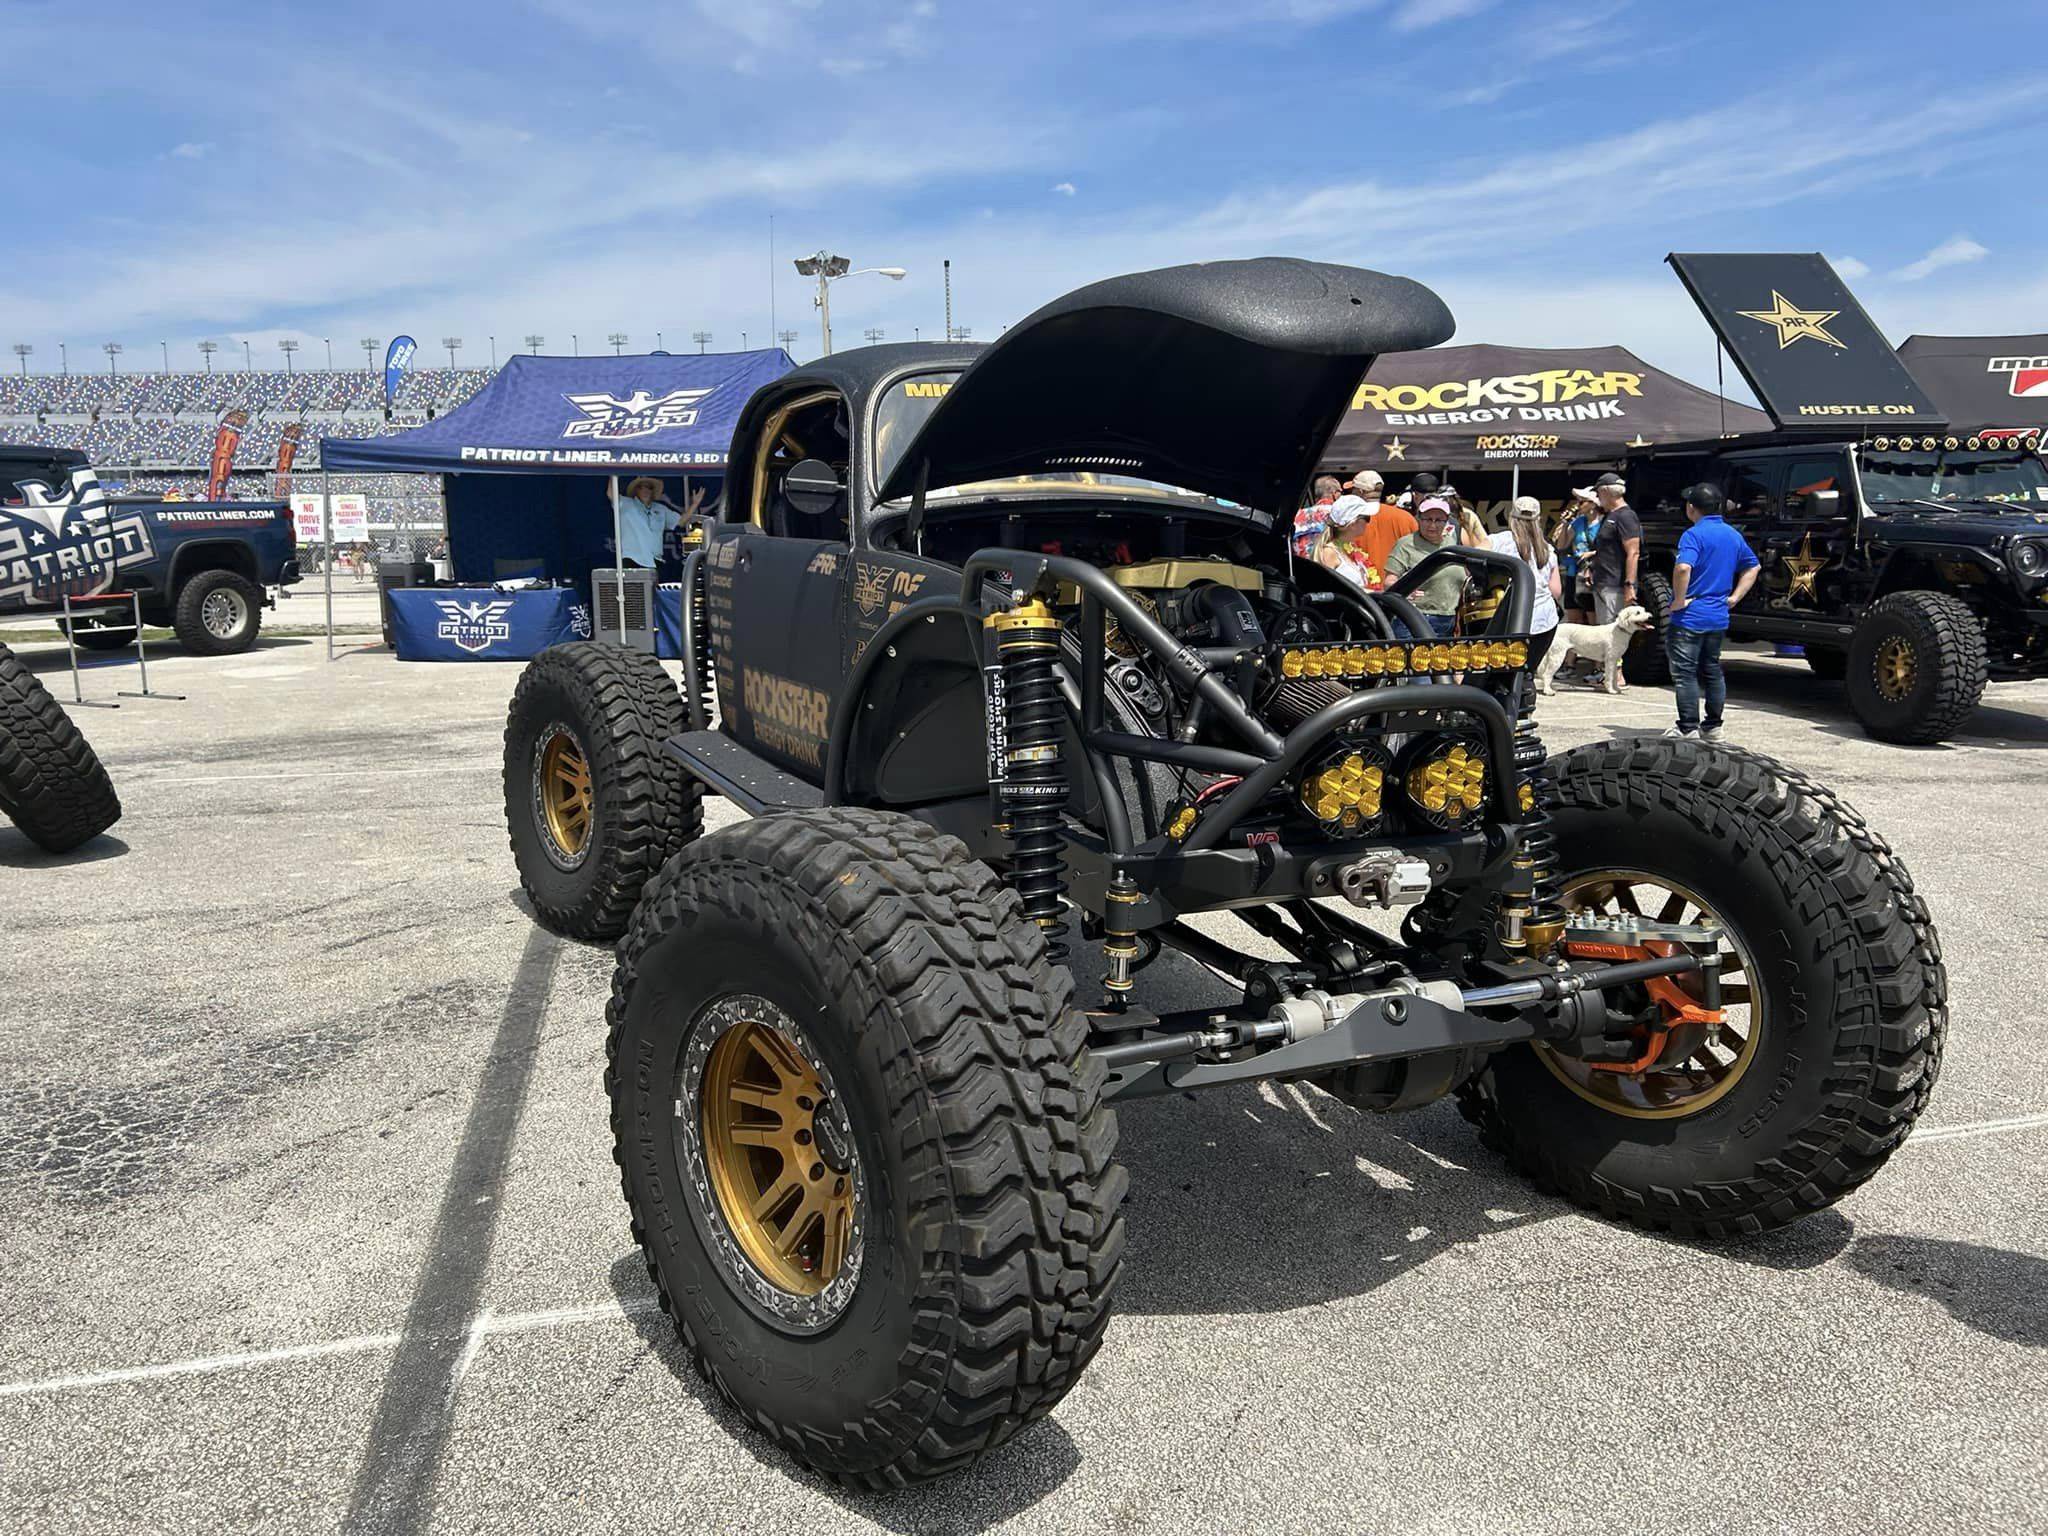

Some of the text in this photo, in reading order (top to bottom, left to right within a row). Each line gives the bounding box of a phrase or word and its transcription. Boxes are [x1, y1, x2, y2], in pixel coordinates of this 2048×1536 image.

[1351, 369, 1644, 411] ROCKSTAR
[1384, 400, 1626, 425] ENERGY DRINK
[1799, 405, 1915, 415] HUSTLE ON
[573, 414, 687, 432] PATRIOT
[1476, 434, 1560, 449] ROCKSTAR
[460, 446, 551, 462] PATRIOT
[620, 452, 692, 464] AMERICA'S
[694, 453, 720, 464] BED
[1484, 450, 1550, 458] ENERGY DRINK
[156, 510, 275, 521] PATRIOTLINER.COM
[303, 503, 314, 513] NO
[301, 526, 320, 536] ZONE
[38, 564, 101, 587] LINER
[442, 625, 505, 635] PATRIOT
[743, 667, 828, 740] ROCKSTAR
